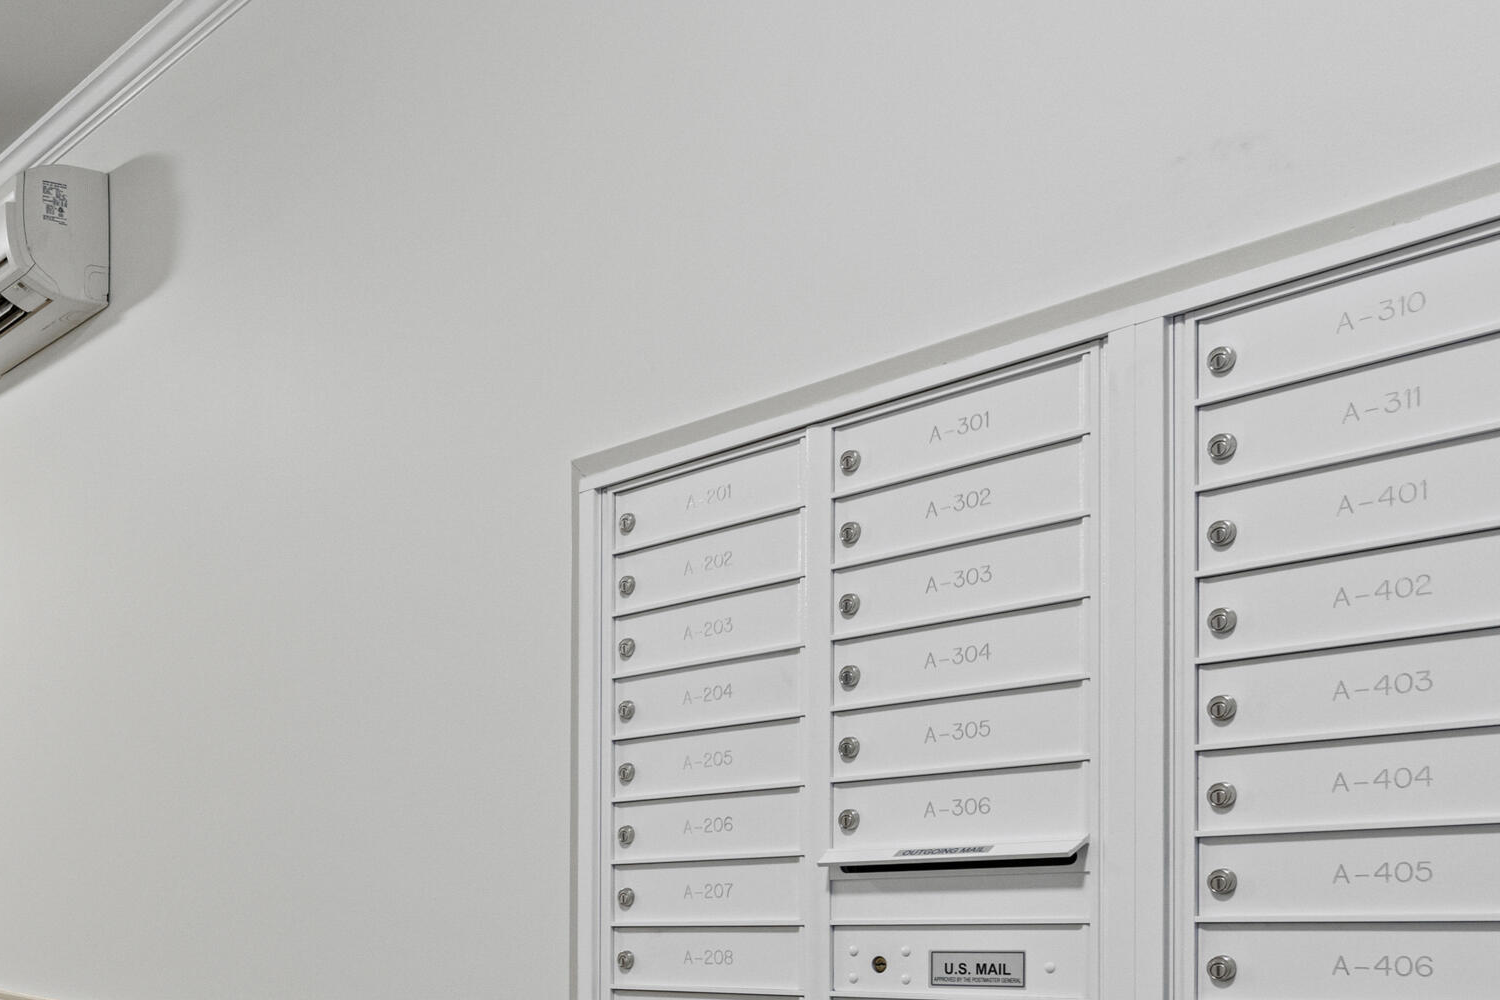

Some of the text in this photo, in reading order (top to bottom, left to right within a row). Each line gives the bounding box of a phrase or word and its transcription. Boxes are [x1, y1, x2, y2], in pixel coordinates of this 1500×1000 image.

[1336, 291, 1427, 334] A-310
[1342, 386, 1420, 424] A-311
[929, 411, 989, 443] A-301
[926, 488, 991, 519] A-302
[1337, 480, 1427, 516] A-401
[925, 565, 992, 594] A-303
[1333, 574, 1432, 608] A-402
[684, 617, 733, 640] A-203
[924, 643, 991, 669] A-304
[683, 683, 732, 705] A-204
[1333, 670, 1433, 701] A-403
[924, 720, 990, 744] A-305
[683, 750, 733, 770] A-205
[1332, 766, 1433, 793] A-404
[924, 797, 991, 818] A-306
[684, 816, 733, 834] A-206
[902, 846, 986, 856] OUTGOING MAIL
[1333, 861, 1433, 884] A-405
[684, 883, 733, 899] A-207
[684, 949, 733, 965] A-208
[1332, 956, 1433, 977] A-406
[944, 963, 1012, 975] U.S. MAIL
